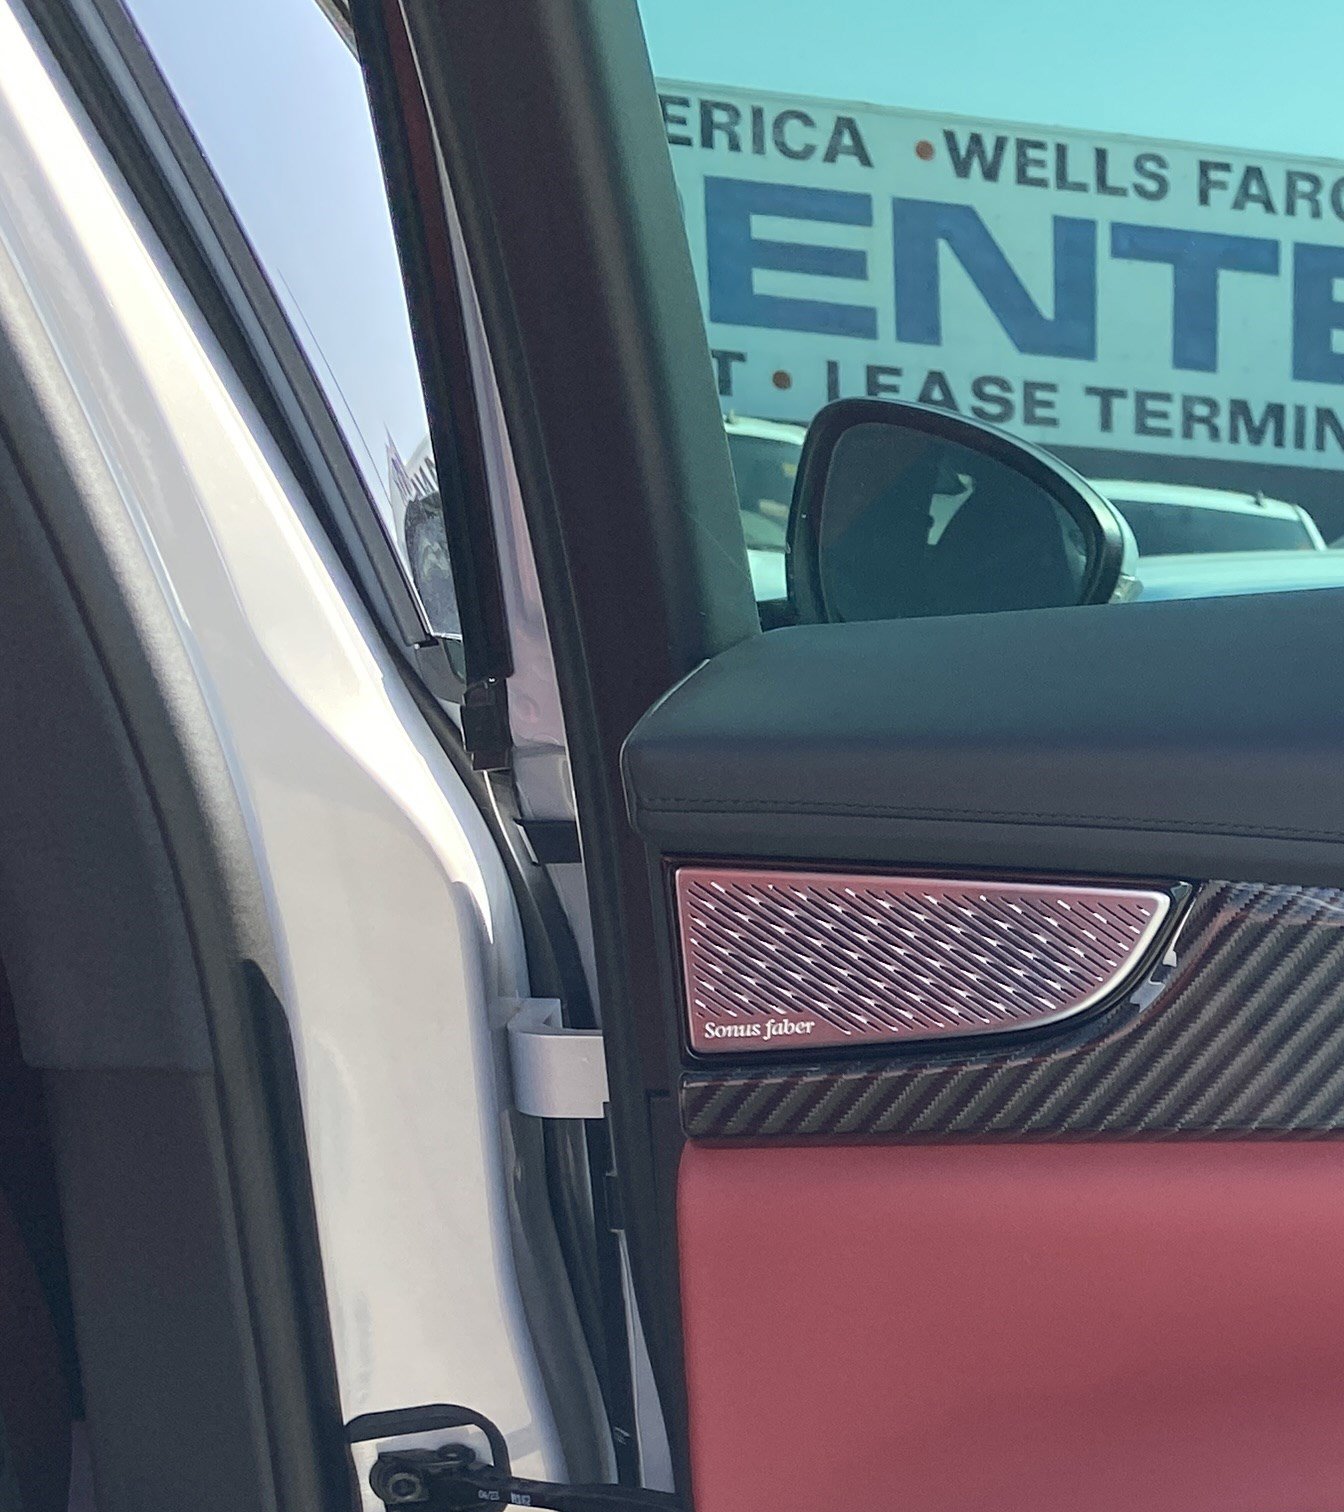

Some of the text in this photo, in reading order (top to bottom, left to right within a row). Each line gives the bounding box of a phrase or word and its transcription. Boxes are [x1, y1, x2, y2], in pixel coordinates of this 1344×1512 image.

[657, 94, 875, 169] ERICA
[942, 128, 1170, 202] WELLS
[704, 1018, 816, 1041] Sonus faber
